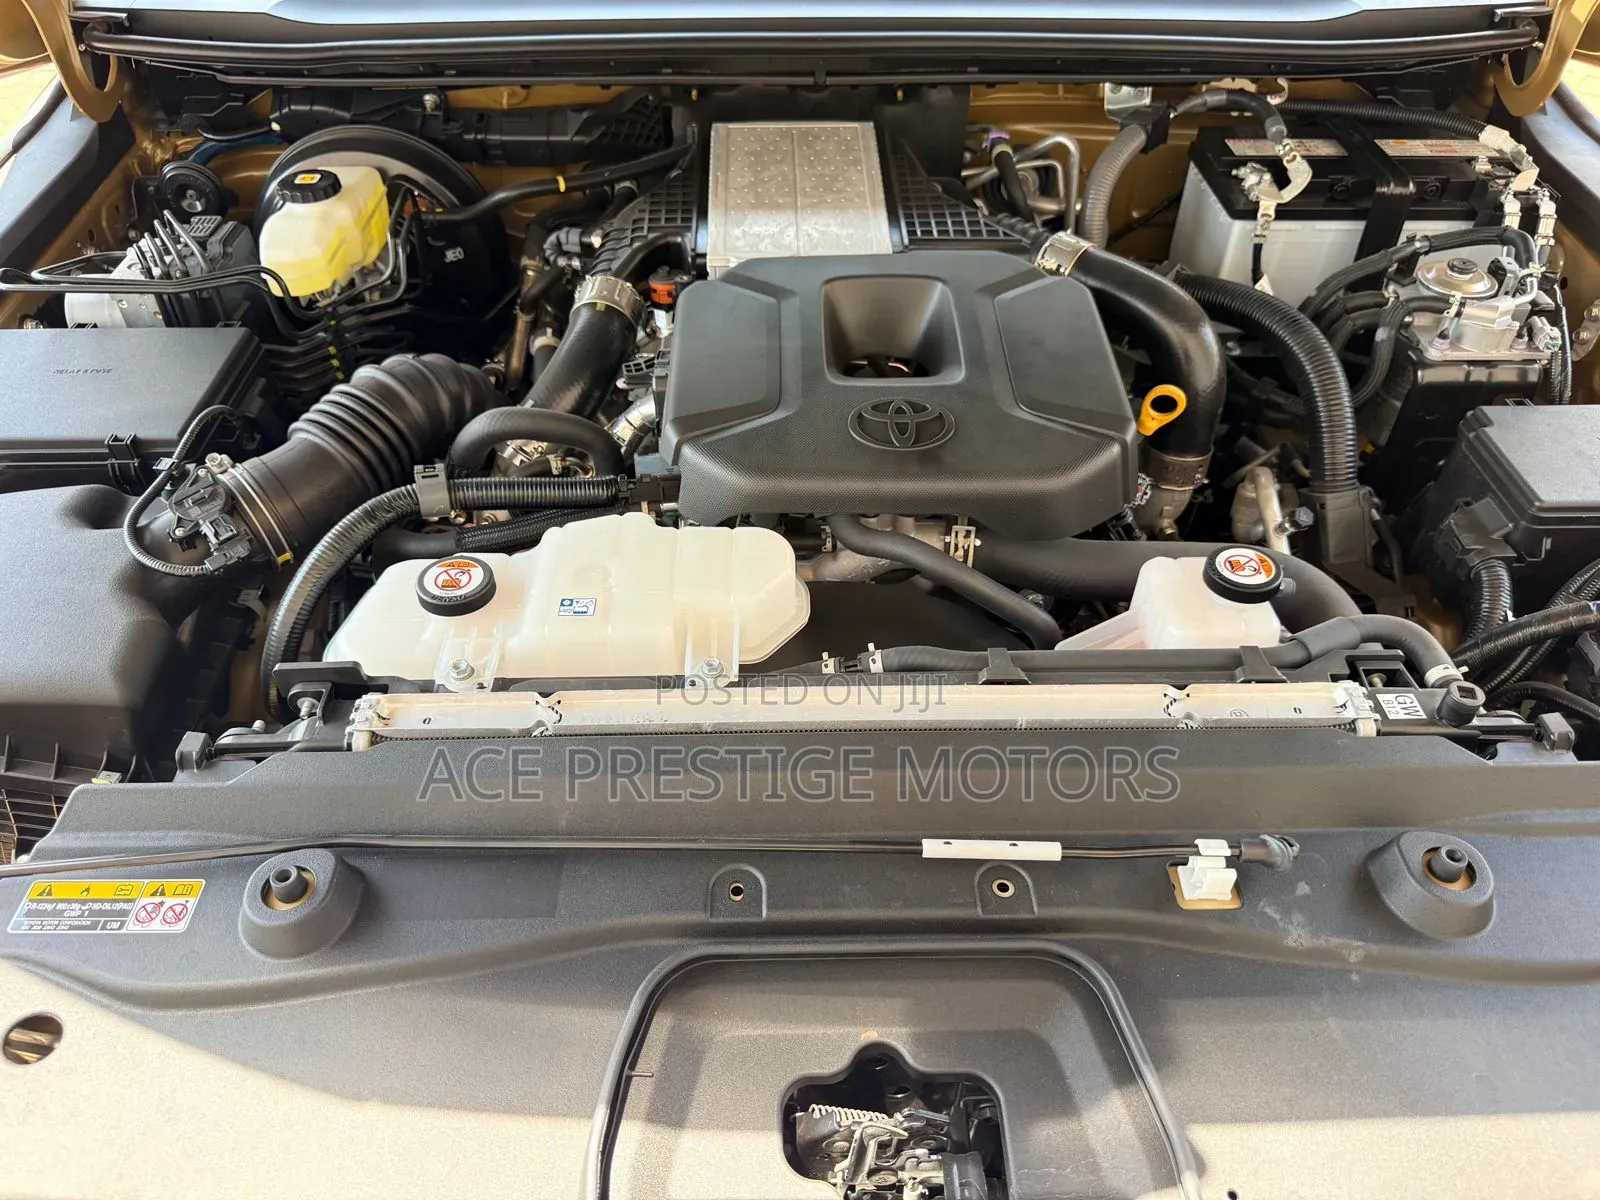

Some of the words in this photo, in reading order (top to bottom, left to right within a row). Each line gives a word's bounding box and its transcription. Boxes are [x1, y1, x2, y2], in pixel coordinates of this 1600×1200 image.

[1382, 699, 1401, 715] B12
[1394, 694, 1424, 718] GW
[63, 910, 83, 918] GWP
[106, 921, 121, 930] UM
